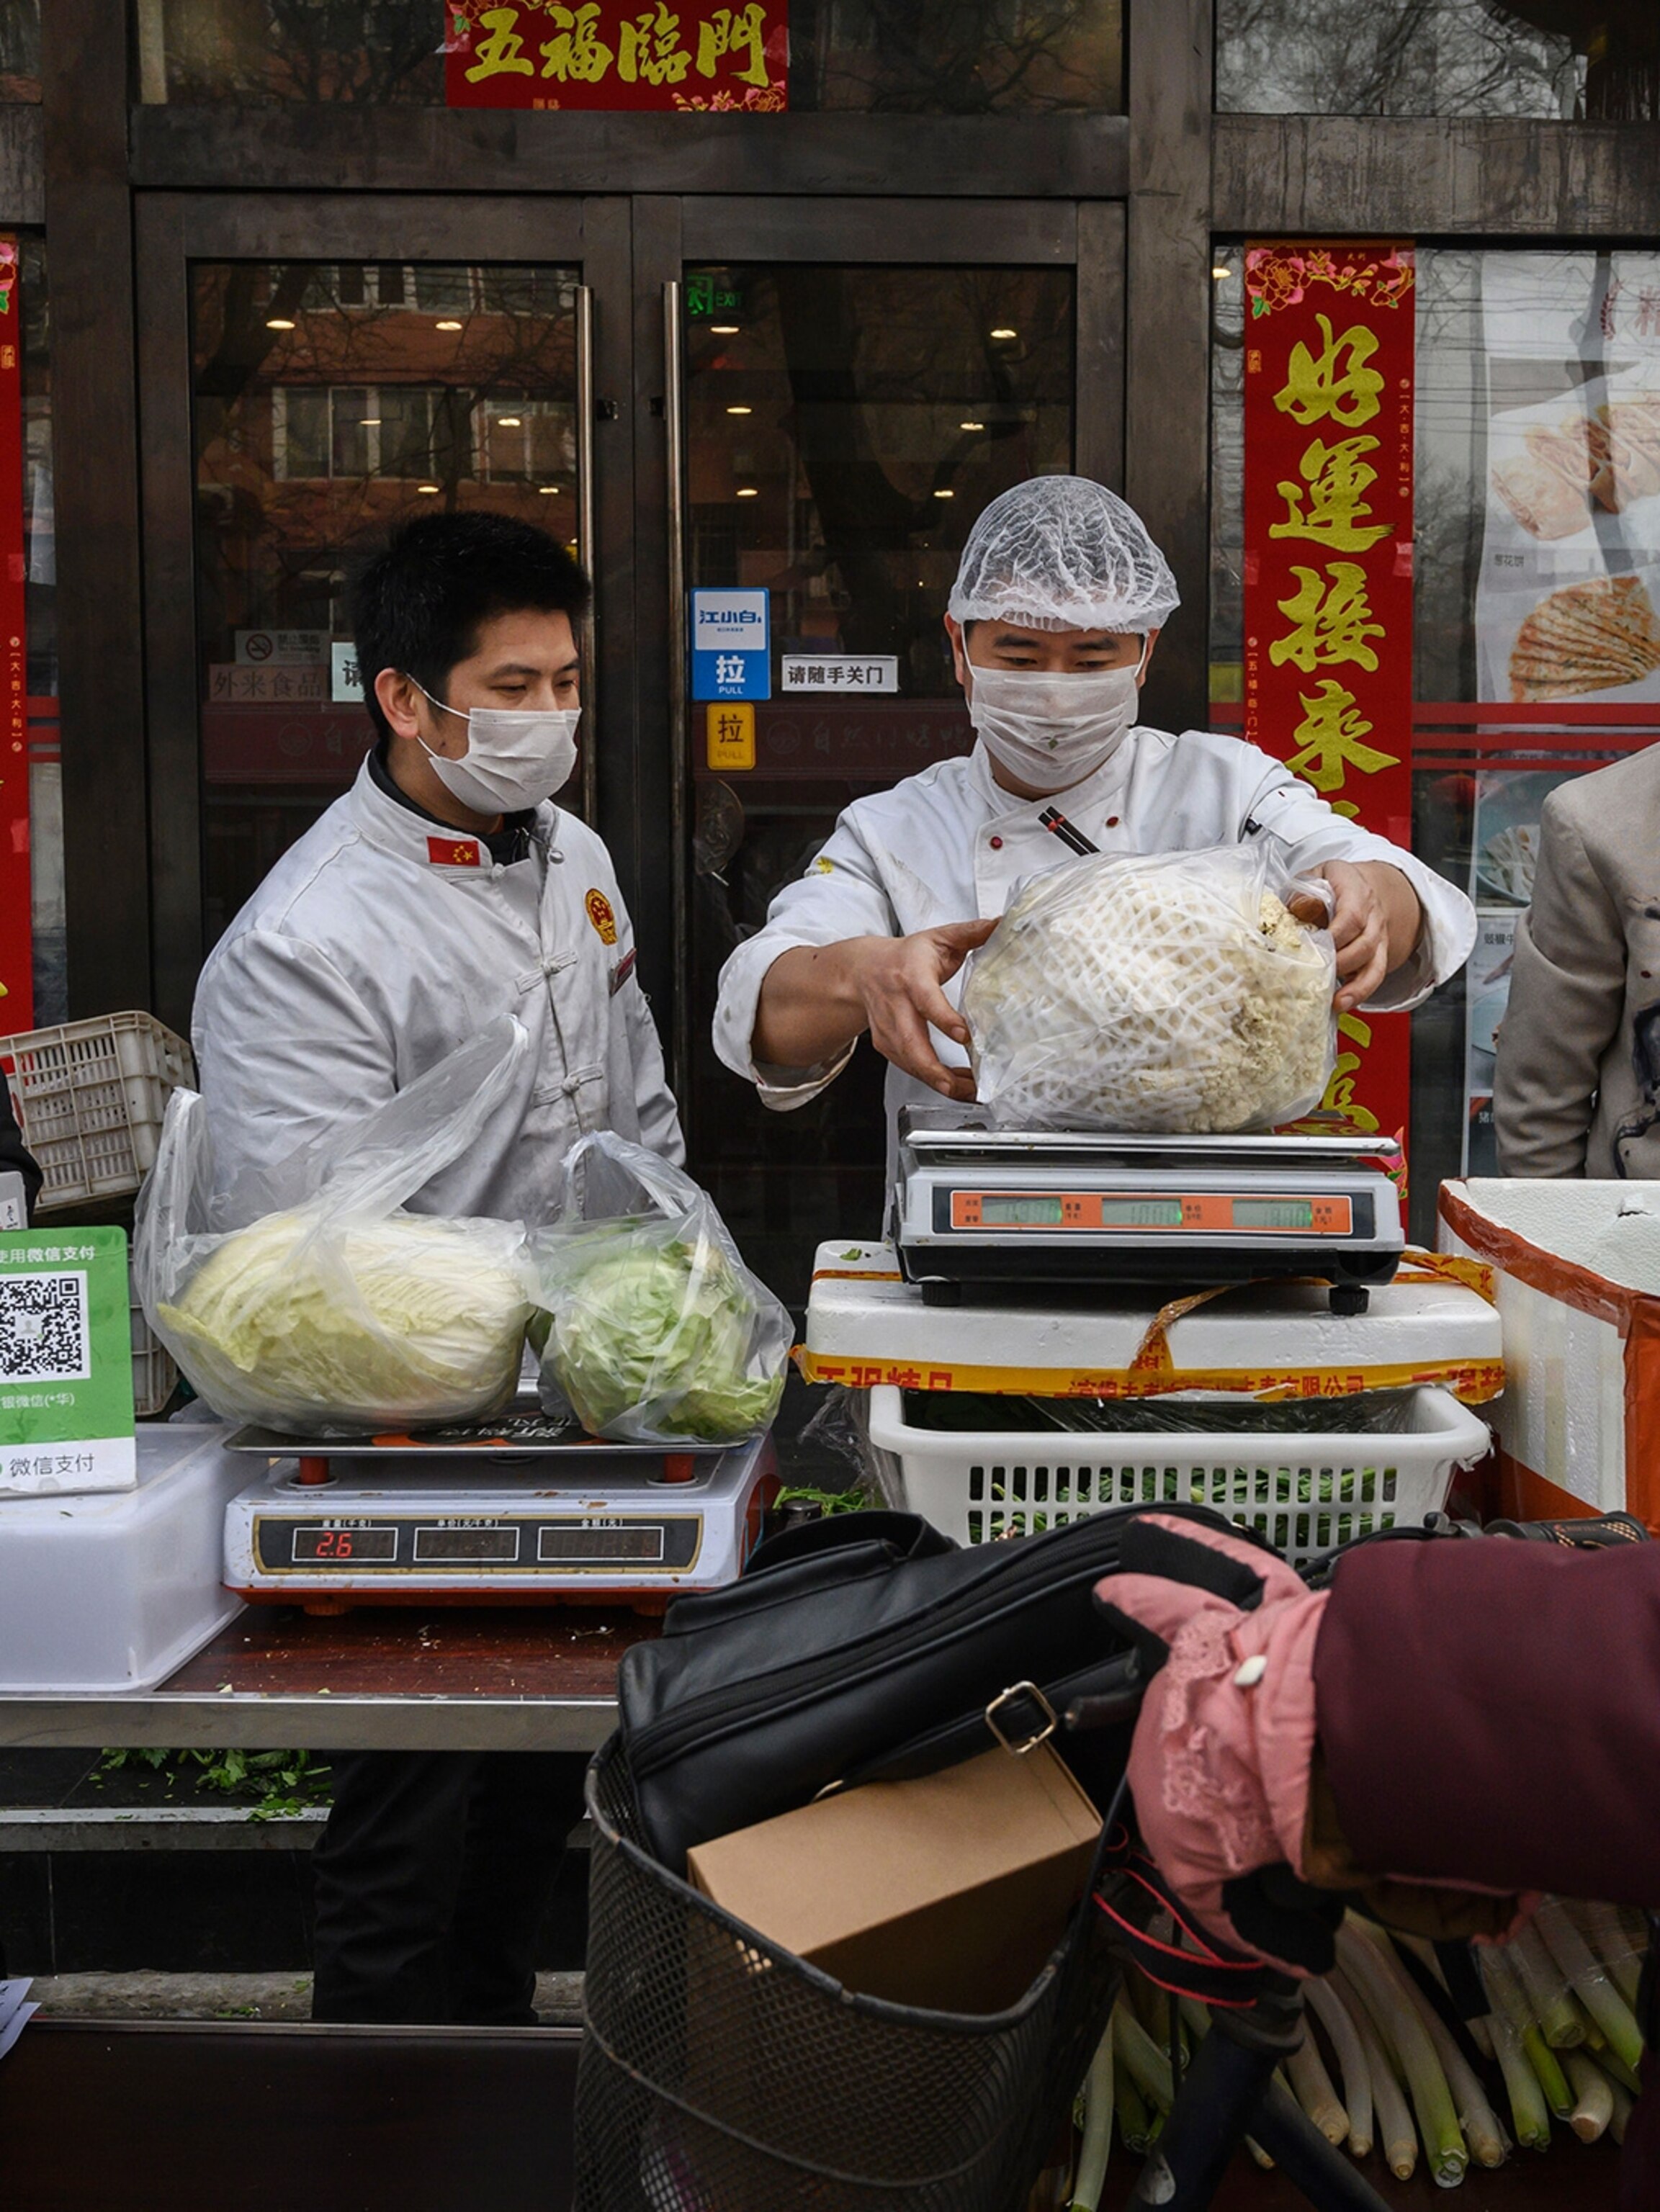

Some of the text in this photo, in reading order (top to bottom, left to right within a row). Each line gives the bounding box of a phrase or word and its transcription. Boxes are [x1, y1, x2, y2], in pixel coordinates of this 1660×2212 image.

[465, 1, 769, 87] 五福臨門
[699, 610, 758, 624] 江小白
[717, 655, 745, 684] 拉
[788, 665, 883, 684] 请随手关门
[213, 671, 320, 698] 外来食品
[719, 685, 743, 694] PULL
[718, 714, 744, 743] 拉
[9, 1453, 94, 1477] 微信支付
[316, 1532, 352, 1557] 2.6
